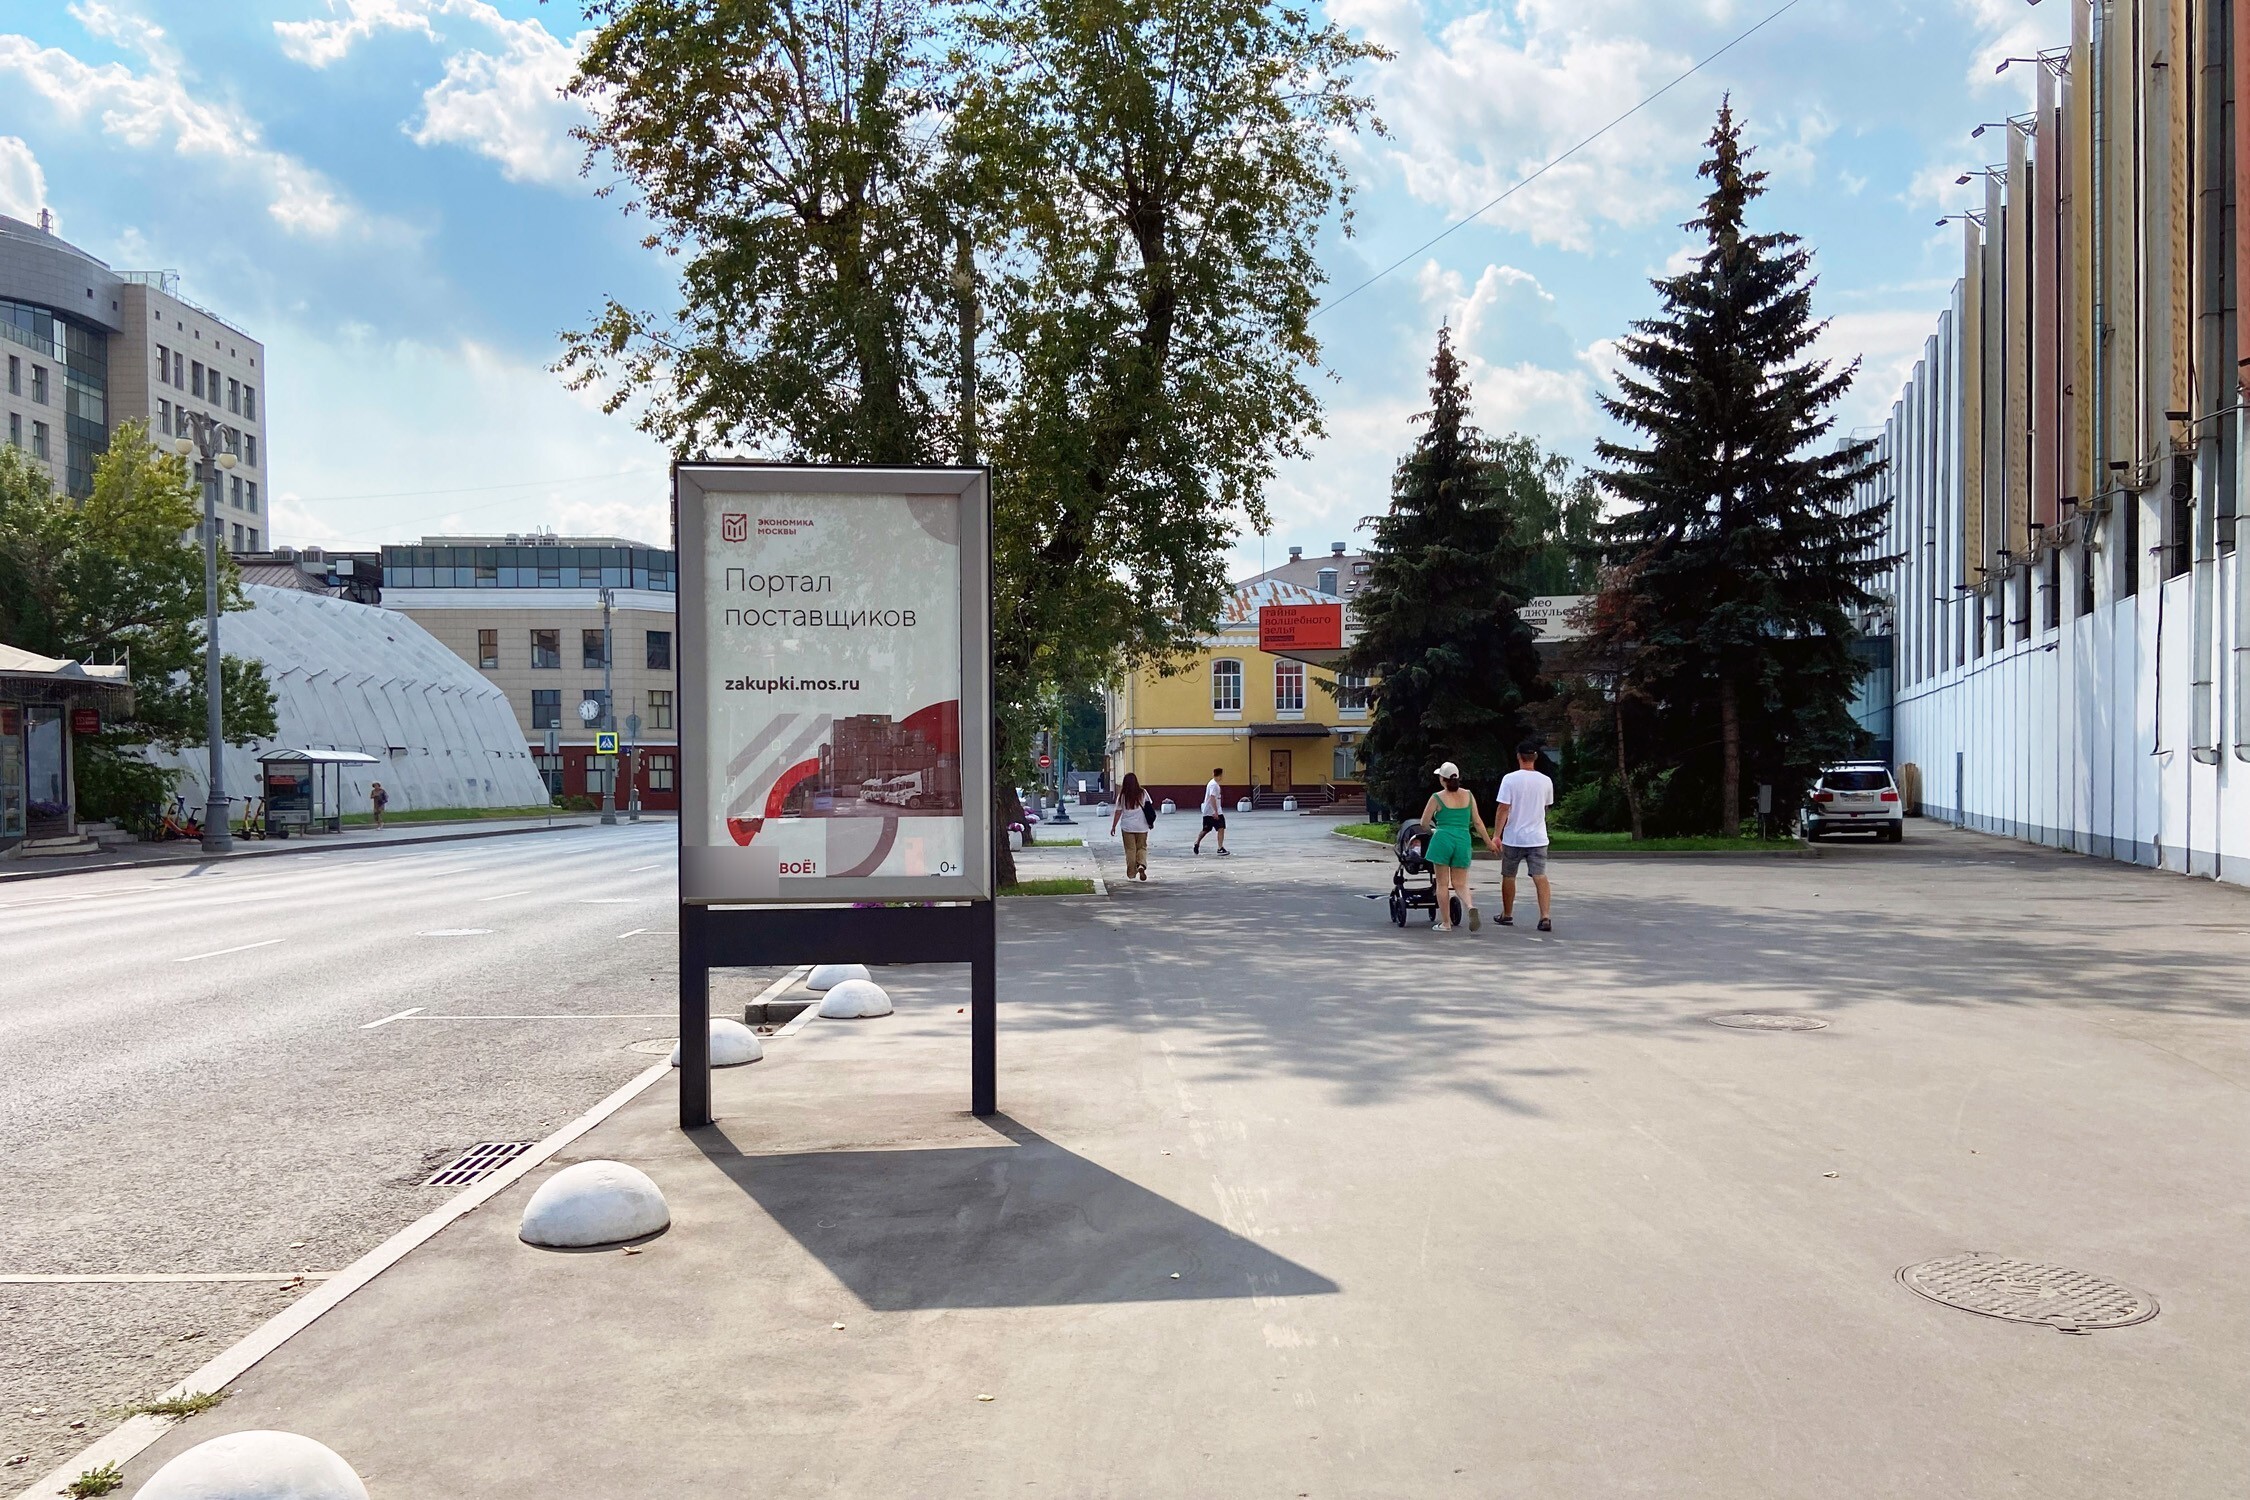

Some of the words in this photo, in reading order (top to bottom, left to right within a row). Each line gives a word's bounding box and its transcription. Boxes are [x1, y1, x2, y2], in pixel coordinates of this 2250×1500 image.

[757, 518, 814, 527] ЭКОНОМИКА
[726, 567, 831, 598] Портал
[1529, 599, 1552, 608] мео
[1264, 607, 1297, 617] тайна
[1523, 607, 1573, 619] джулье
[725, 609, 916, 631] поставщиков
[1264, 615, 1331, 626] волшебного
[1264, 626, 1295, 635] зелья
[725, 676, 860, 694] zakupki.mos.ru
[779, 859, 816, 874] ВОЁ!
[940, 861, 957, 873] 0+
